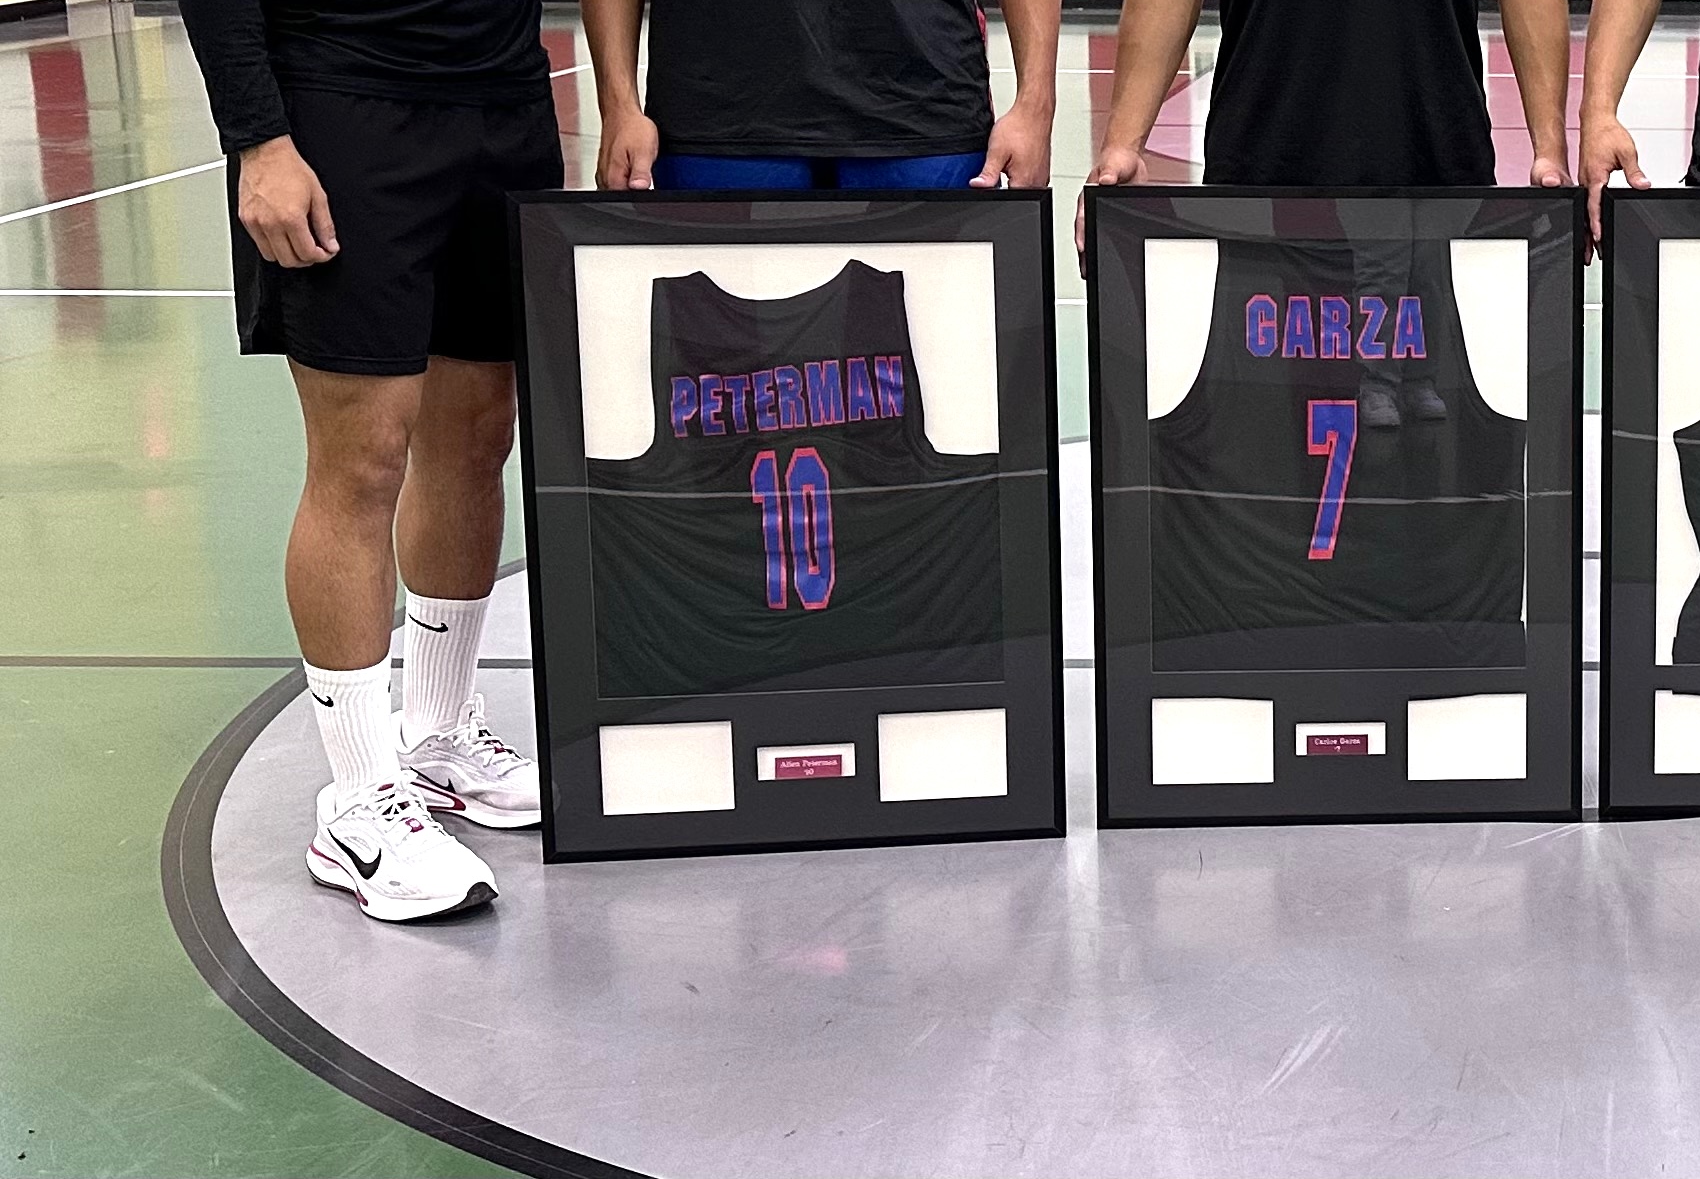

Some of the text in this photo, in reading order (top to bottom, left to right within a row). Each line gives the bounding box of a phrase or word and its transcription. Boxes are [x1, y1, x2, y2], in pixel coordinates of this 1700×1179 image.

[1245, 293, 1428, 360] GARZA
[669, 355, 905, 439] PETERMAN
[750, 446, 836, 611] 10
[1307, 399, 1358, 561] 7
